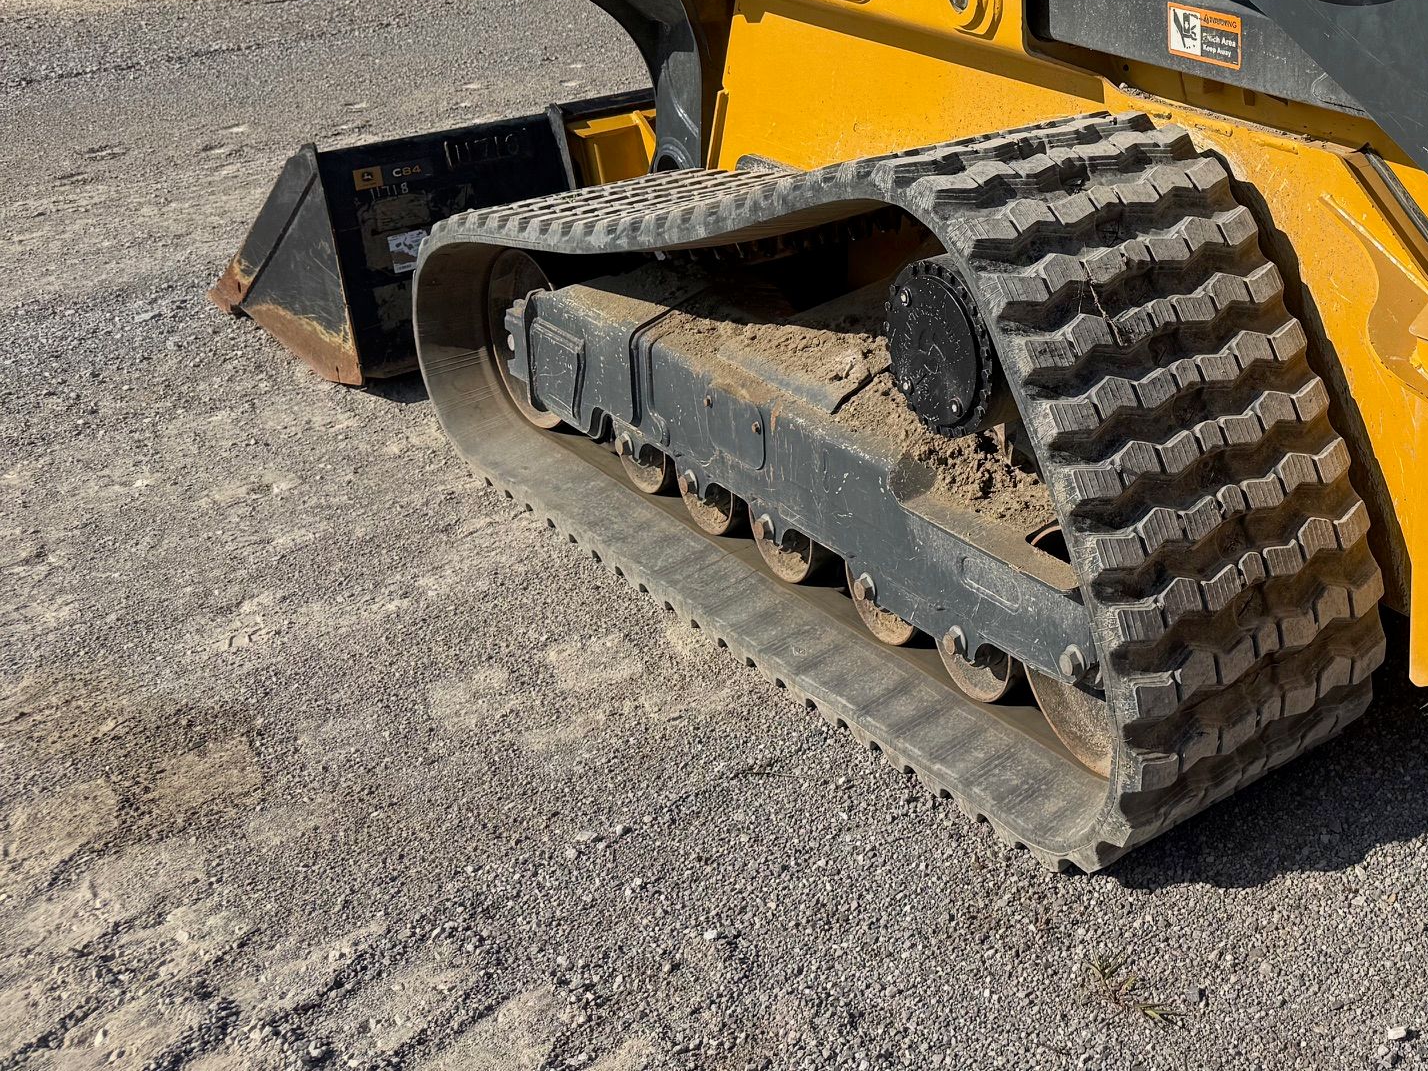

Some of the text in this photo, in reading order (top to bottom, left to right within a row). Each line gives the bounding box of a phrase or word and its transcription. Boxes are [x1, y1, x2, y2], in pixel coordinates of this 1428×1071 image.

[1221, 37, 1236, 47] Area
[1202, 44, 1232, 57] Keep Away
[392, 164, 422, 178] C84
